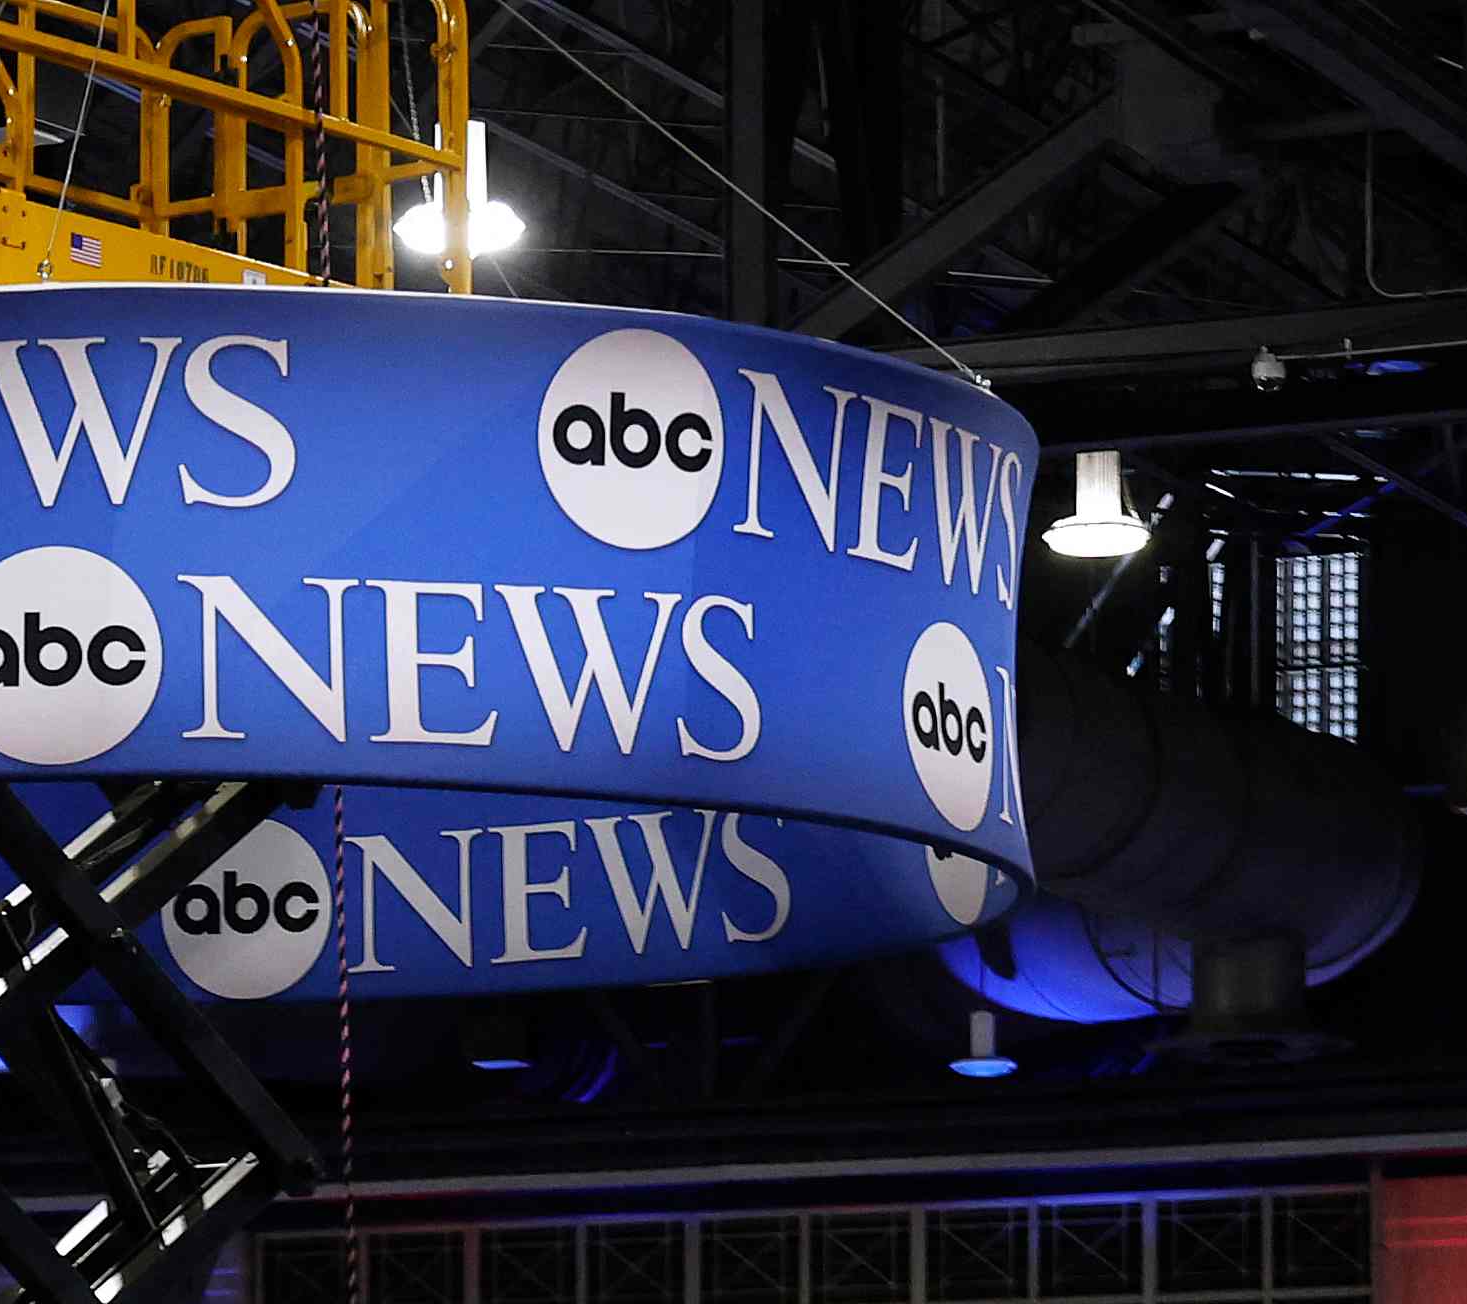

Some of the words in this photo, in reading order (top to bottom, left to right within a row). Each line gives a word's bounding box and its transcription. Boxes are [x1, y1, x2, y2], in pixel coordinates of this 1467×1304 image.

[553, 392, 712, 473] abc
[733, 367, 1023, 610] NEWS
[179, 573, 763, 762] NEWS
[912, 681, 987, 764] abc
[173, 870, 320, 936] abc
[346, 808, 792, 974] NEWS
